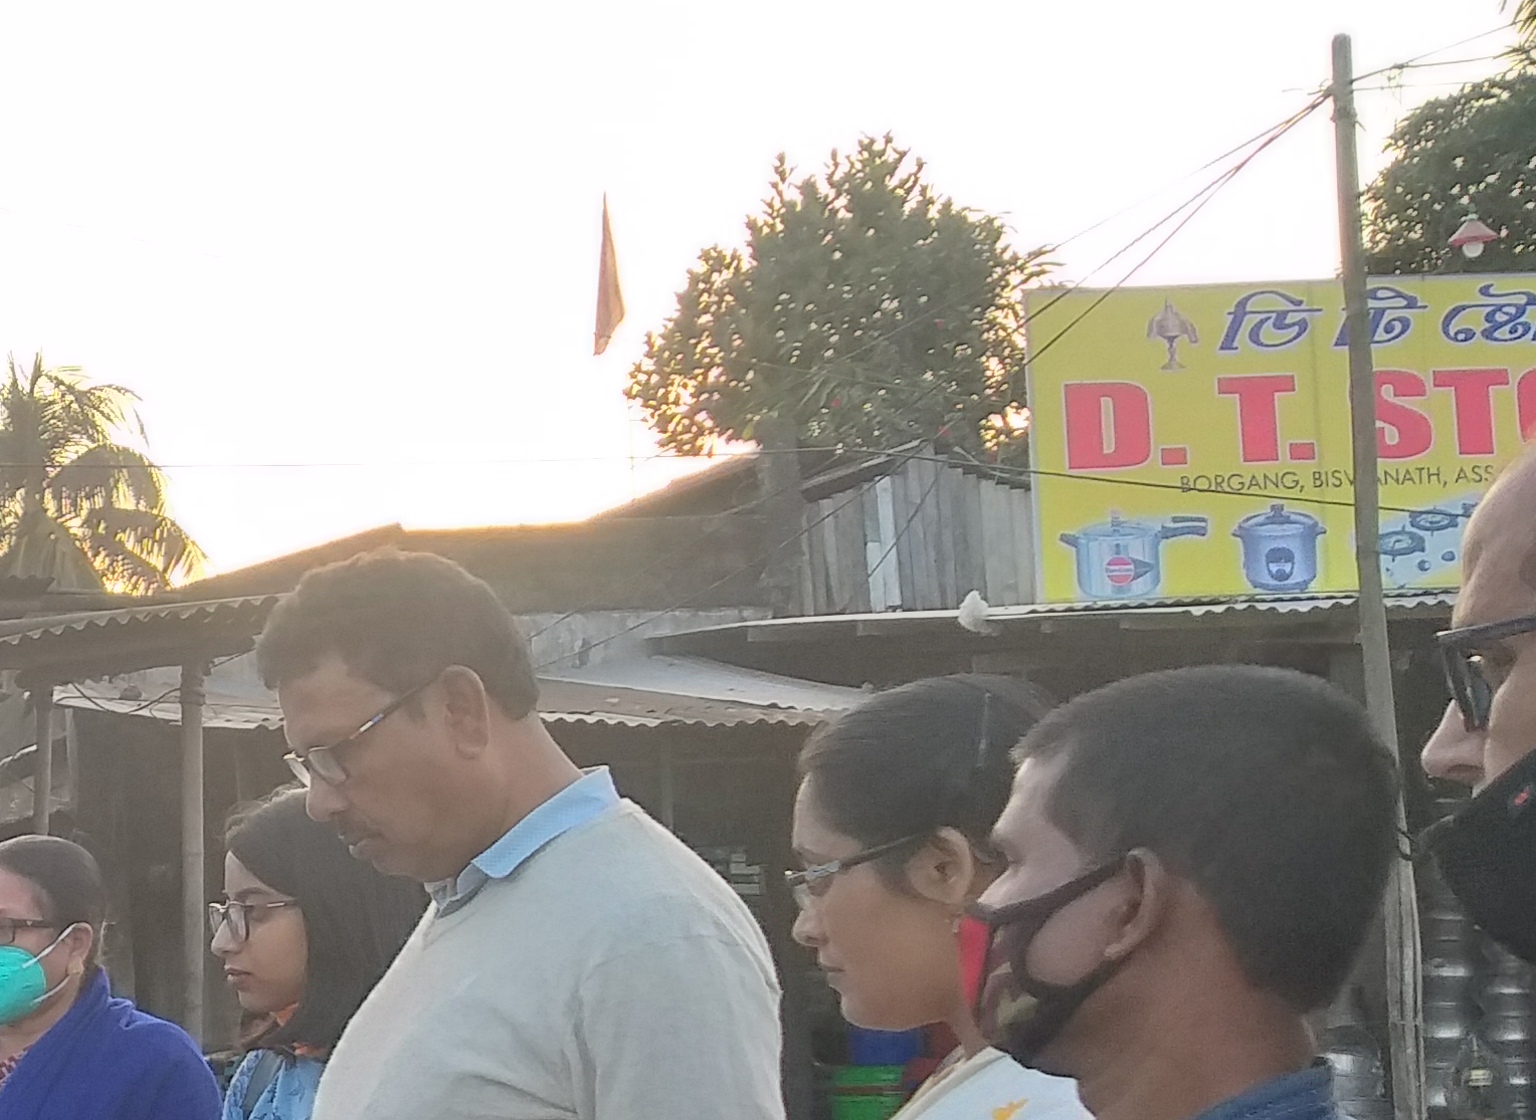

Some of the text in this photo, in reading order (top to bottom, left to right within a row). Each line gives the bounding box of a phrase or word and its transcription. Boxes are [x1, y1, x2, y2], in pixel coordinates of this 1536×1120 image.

[1218, 290, 1323, 350] ডি
[1063, 367, 1536, 470] D. T. ST
[1180, 471, 1305, 493] BORGANG,
